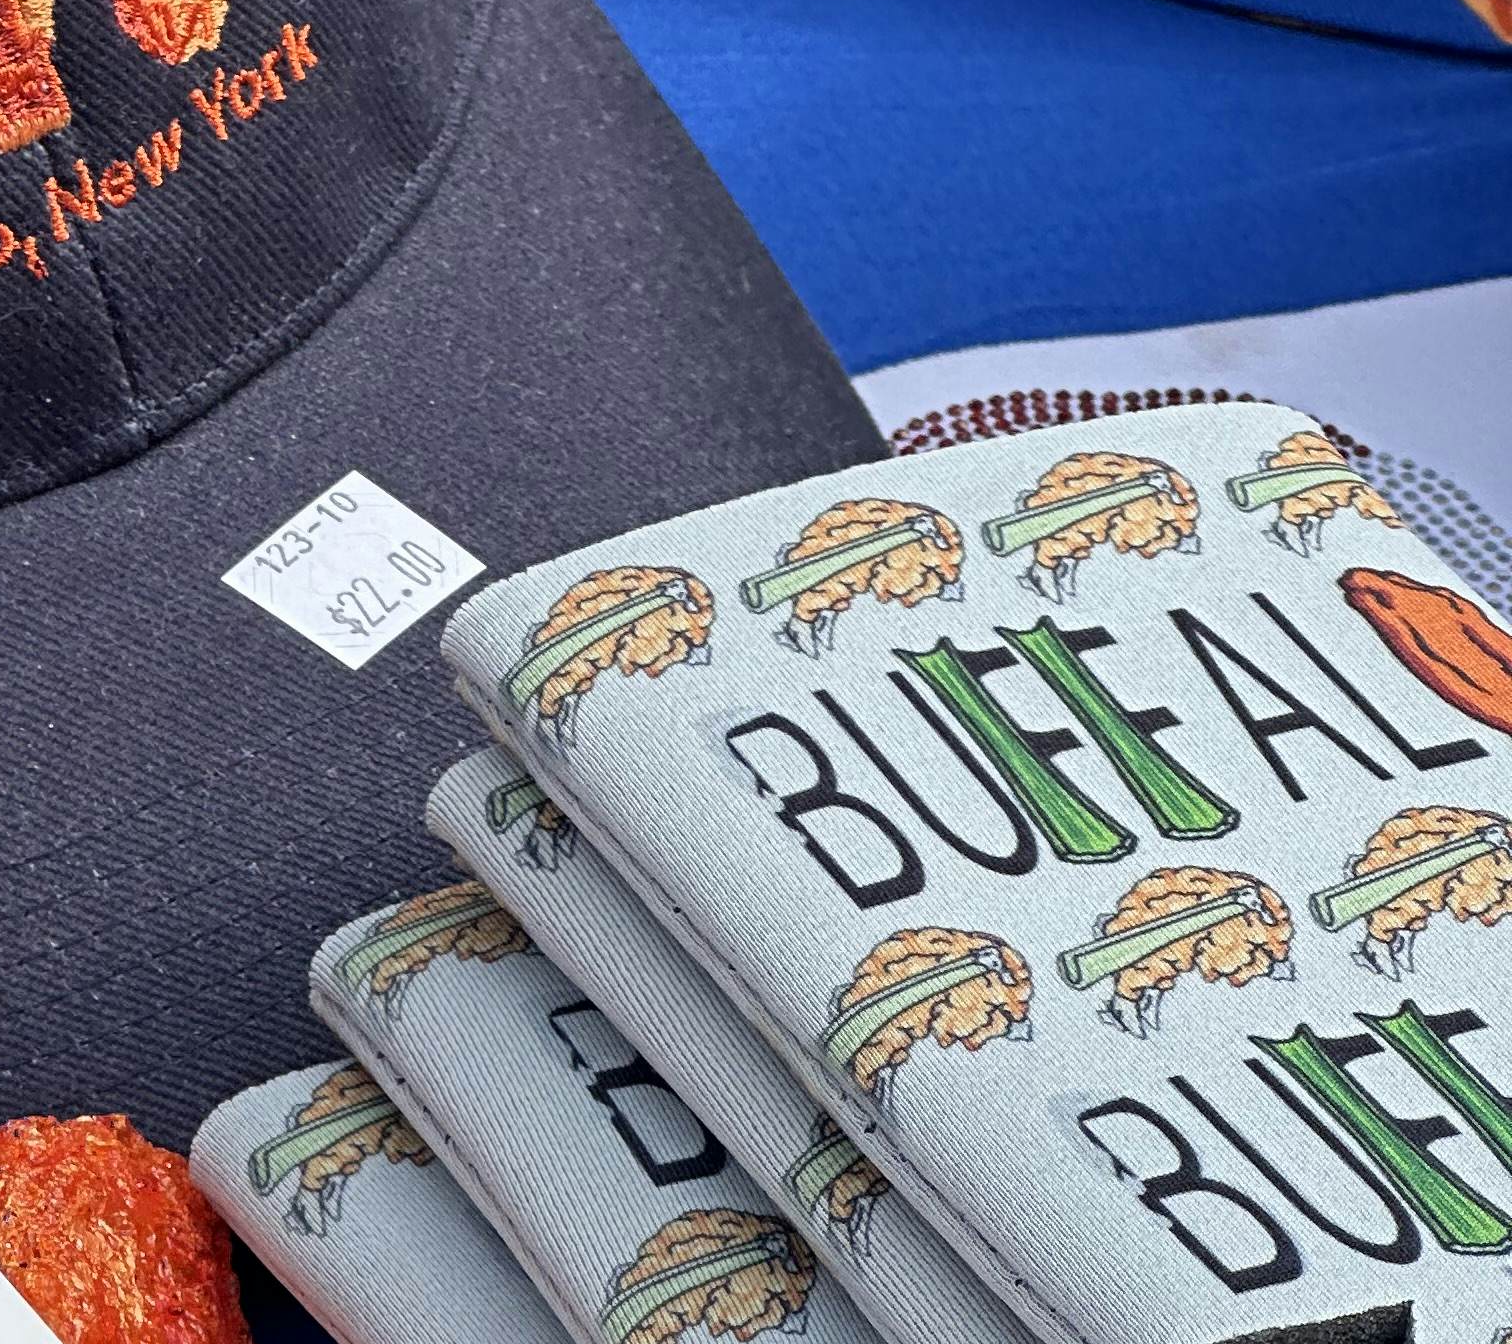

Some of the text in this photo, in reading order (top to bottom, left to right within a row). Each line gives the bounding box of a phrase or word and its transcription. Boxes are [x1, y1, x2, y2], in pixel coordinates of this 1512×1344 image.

[44, 118, 183, 242] New
[191, 22, 319, 141] York
[254, 492, 358, 574] 123-10
[326, 541, 446, 637] $22.00
